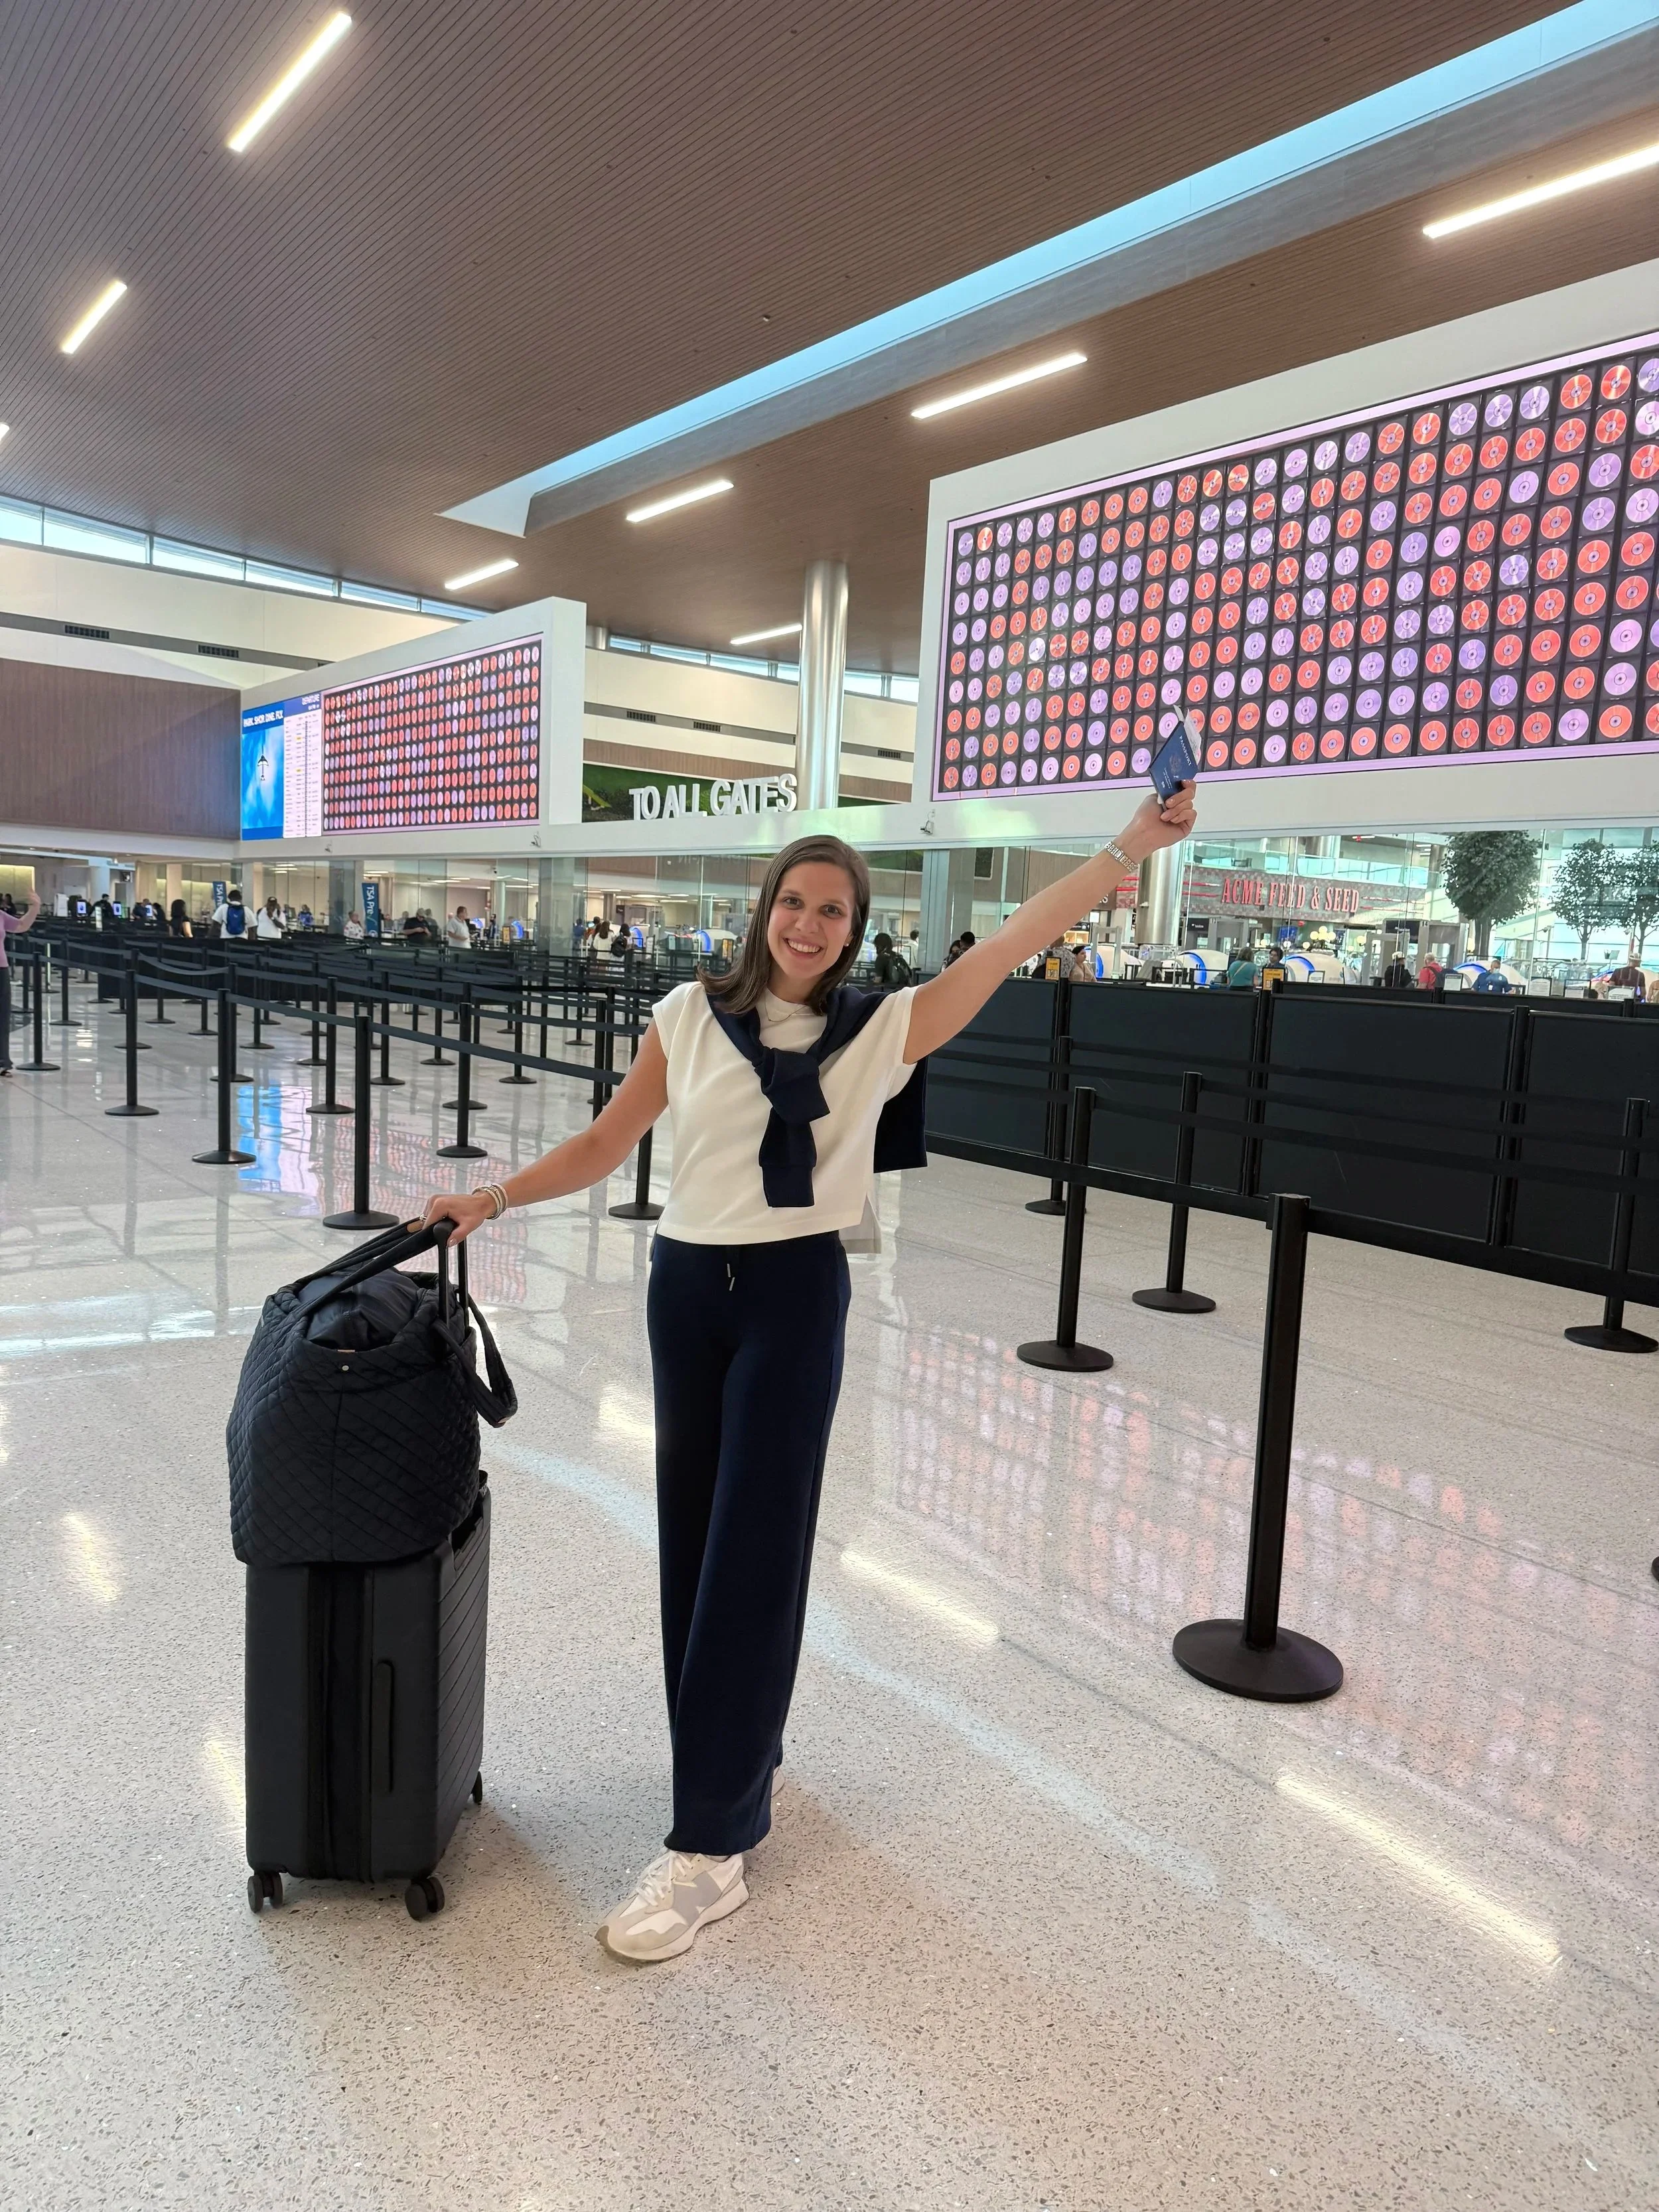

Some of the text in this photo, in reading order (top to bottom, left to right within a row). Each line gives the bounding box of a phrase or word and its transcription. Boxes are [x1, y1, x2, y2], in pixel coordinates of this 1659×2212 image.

[1179, 735, 1192, 766] PASSPORT
[628, 773, 798, 820] TO ALL GATES
[366, 885, 375, 901] TSA
[1222, 878, 1360, 913] ACME FEED & SEED
